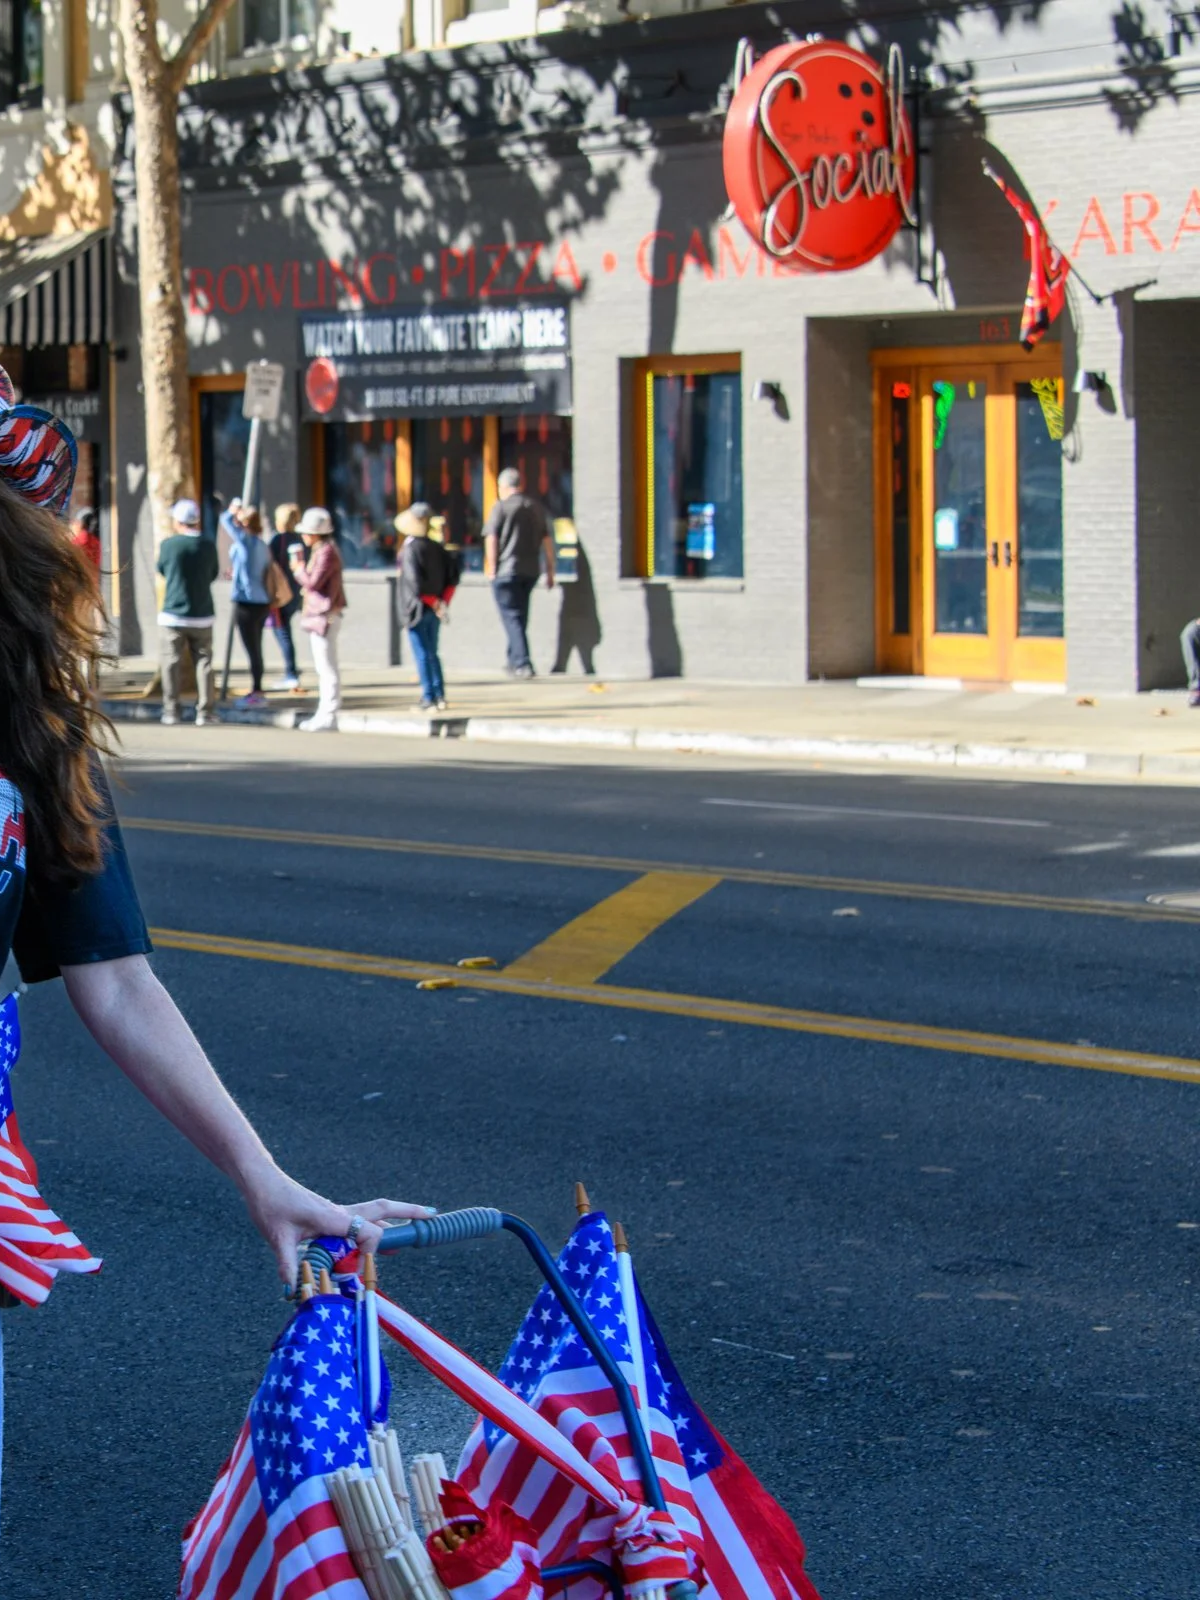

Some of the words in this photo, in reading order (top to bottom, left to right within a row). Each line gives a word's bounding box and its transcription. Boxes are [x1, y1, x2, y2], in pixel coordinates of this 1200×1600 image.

[759, 42, 918, 257] Social
[188, 253, 397, 315] BOWLING
[439, 239, 586, 299] PIZZA
[637, 226, 826, 288] GAM
[302, 320, 354, 357] WATCH
[354, 317, 394, 354] YOUR
[396, 314, 467, 353] FAVORITE
[468, 310, 522, 350] TEAMS
[523, 307, 567, 347] HERE
